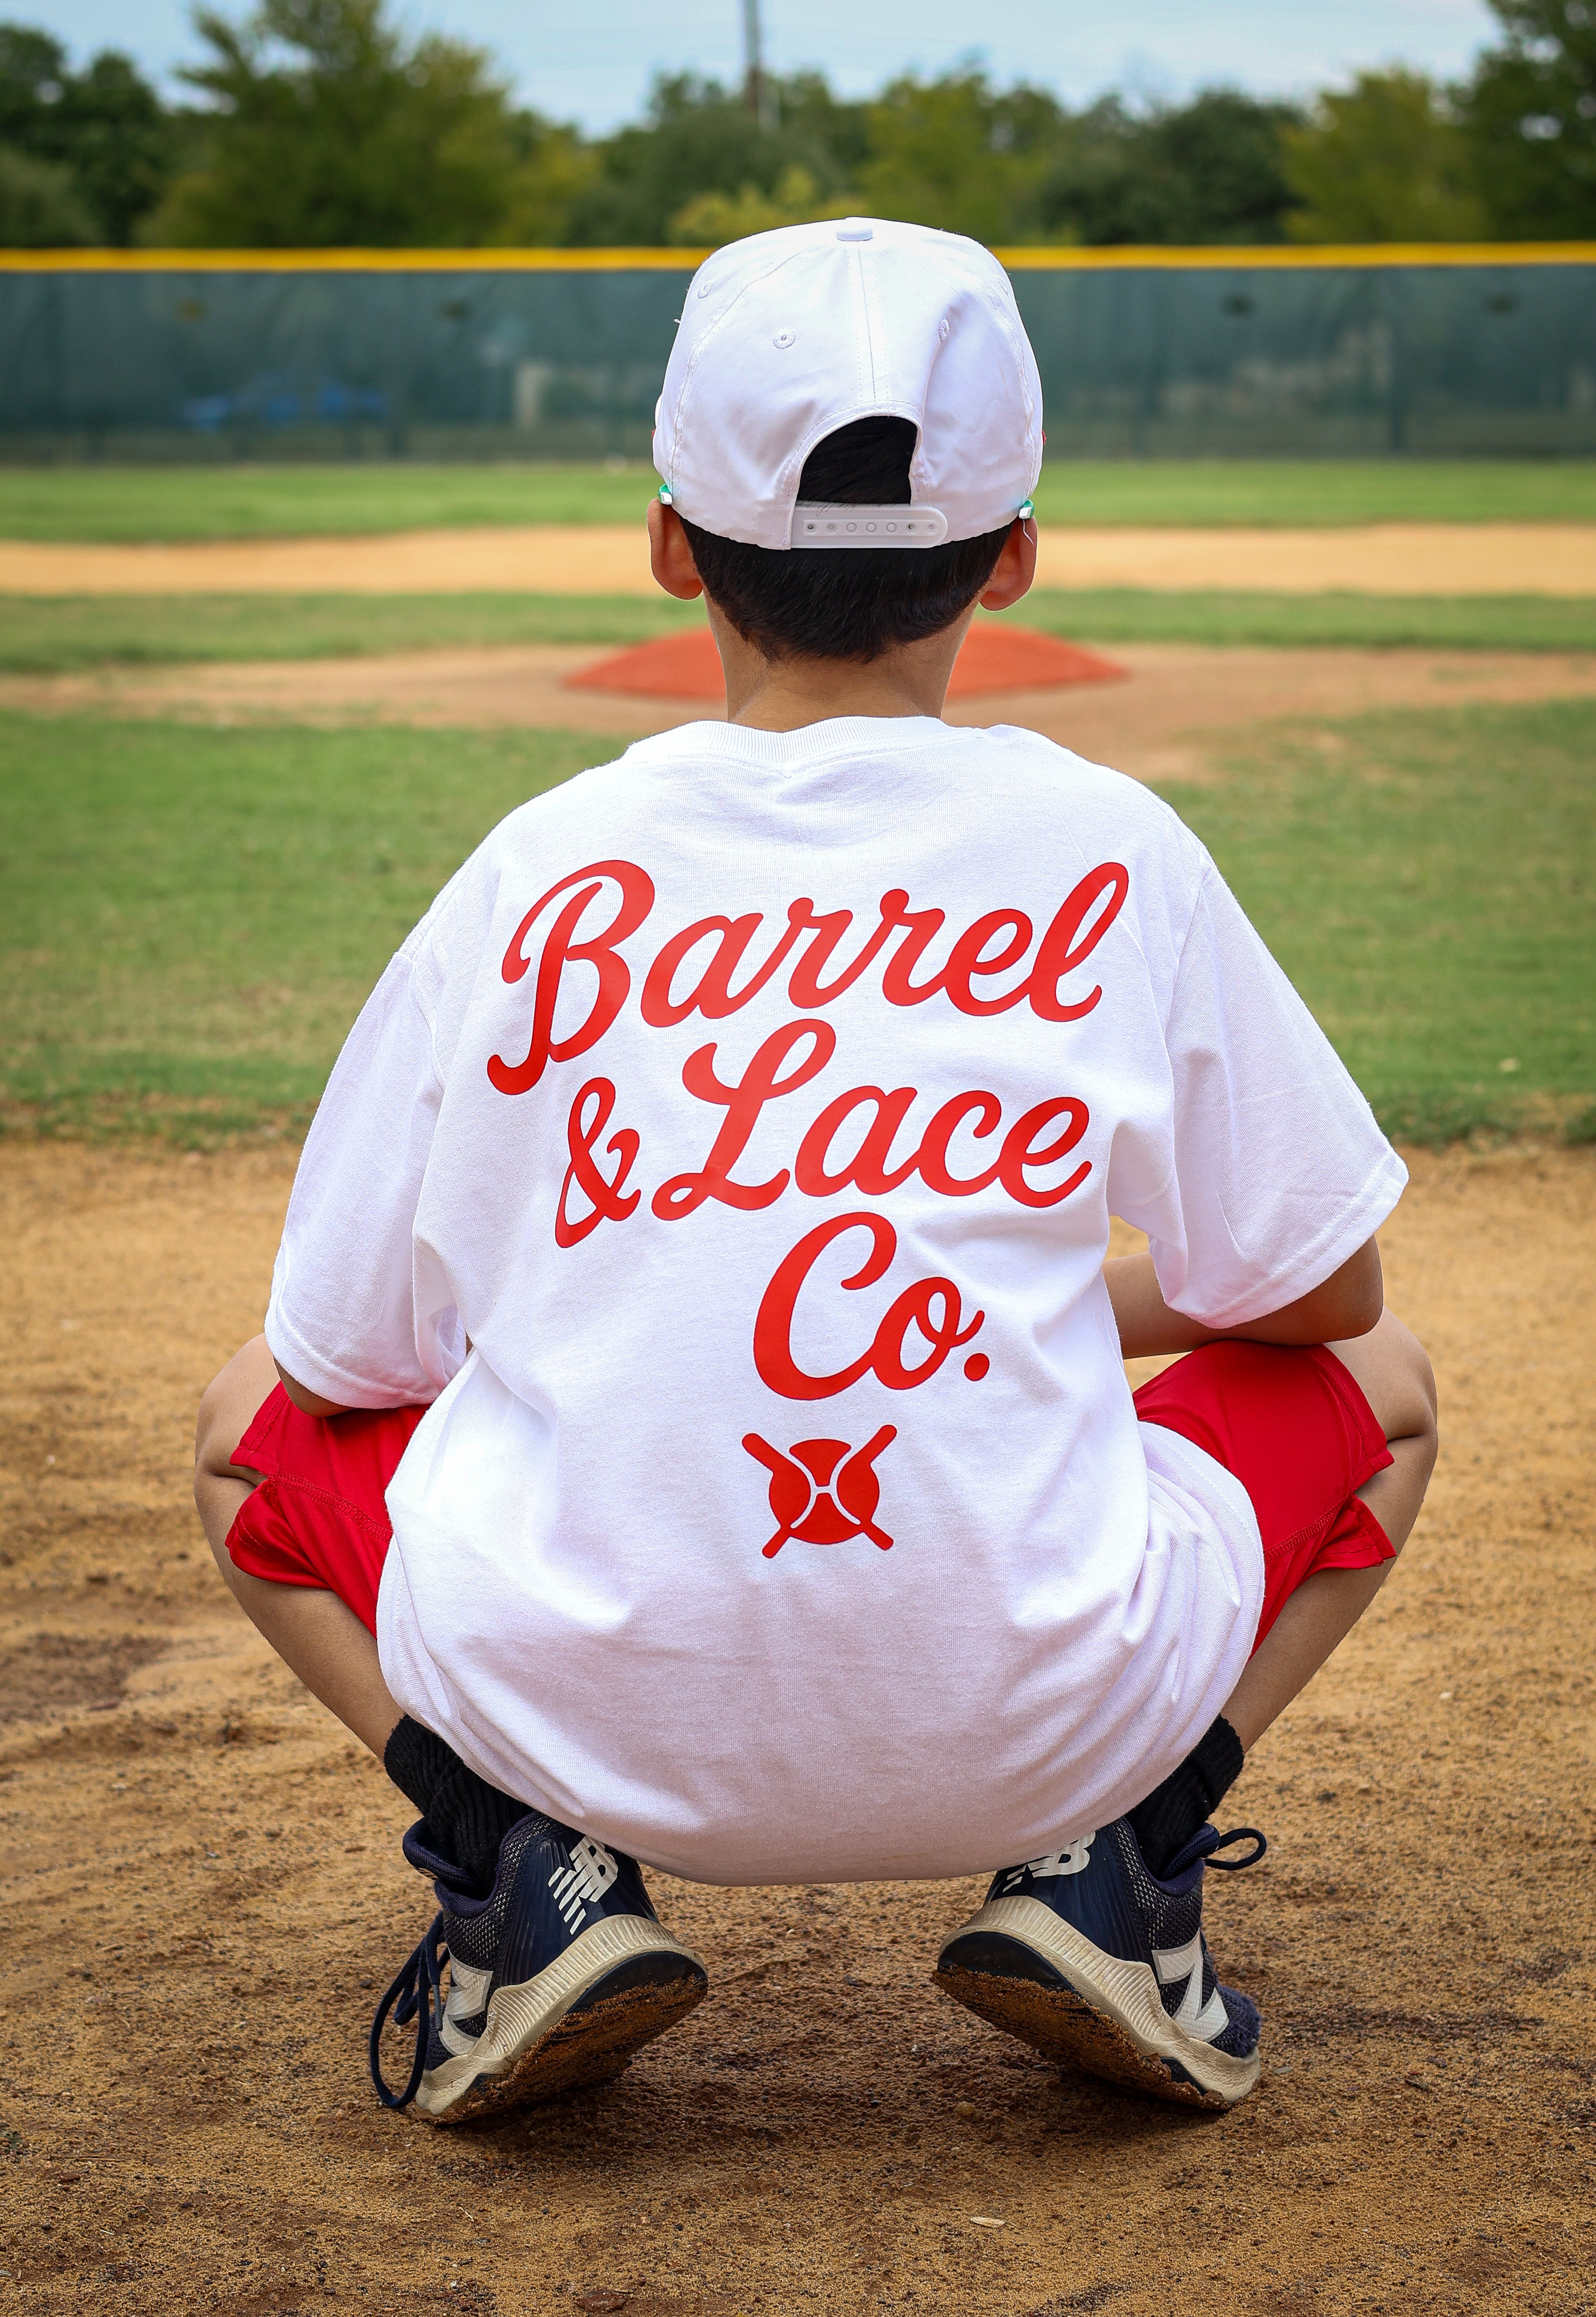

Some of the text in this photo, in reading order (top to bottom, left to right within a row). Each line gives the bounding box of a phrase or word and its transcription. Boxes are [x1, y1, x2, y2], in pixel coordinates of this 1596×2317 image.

[487, 860, 1129, 1095] Barrel
[555, 1019, 1092, 1248] & Lace
[753, 1212, 990, 1400] Co.
